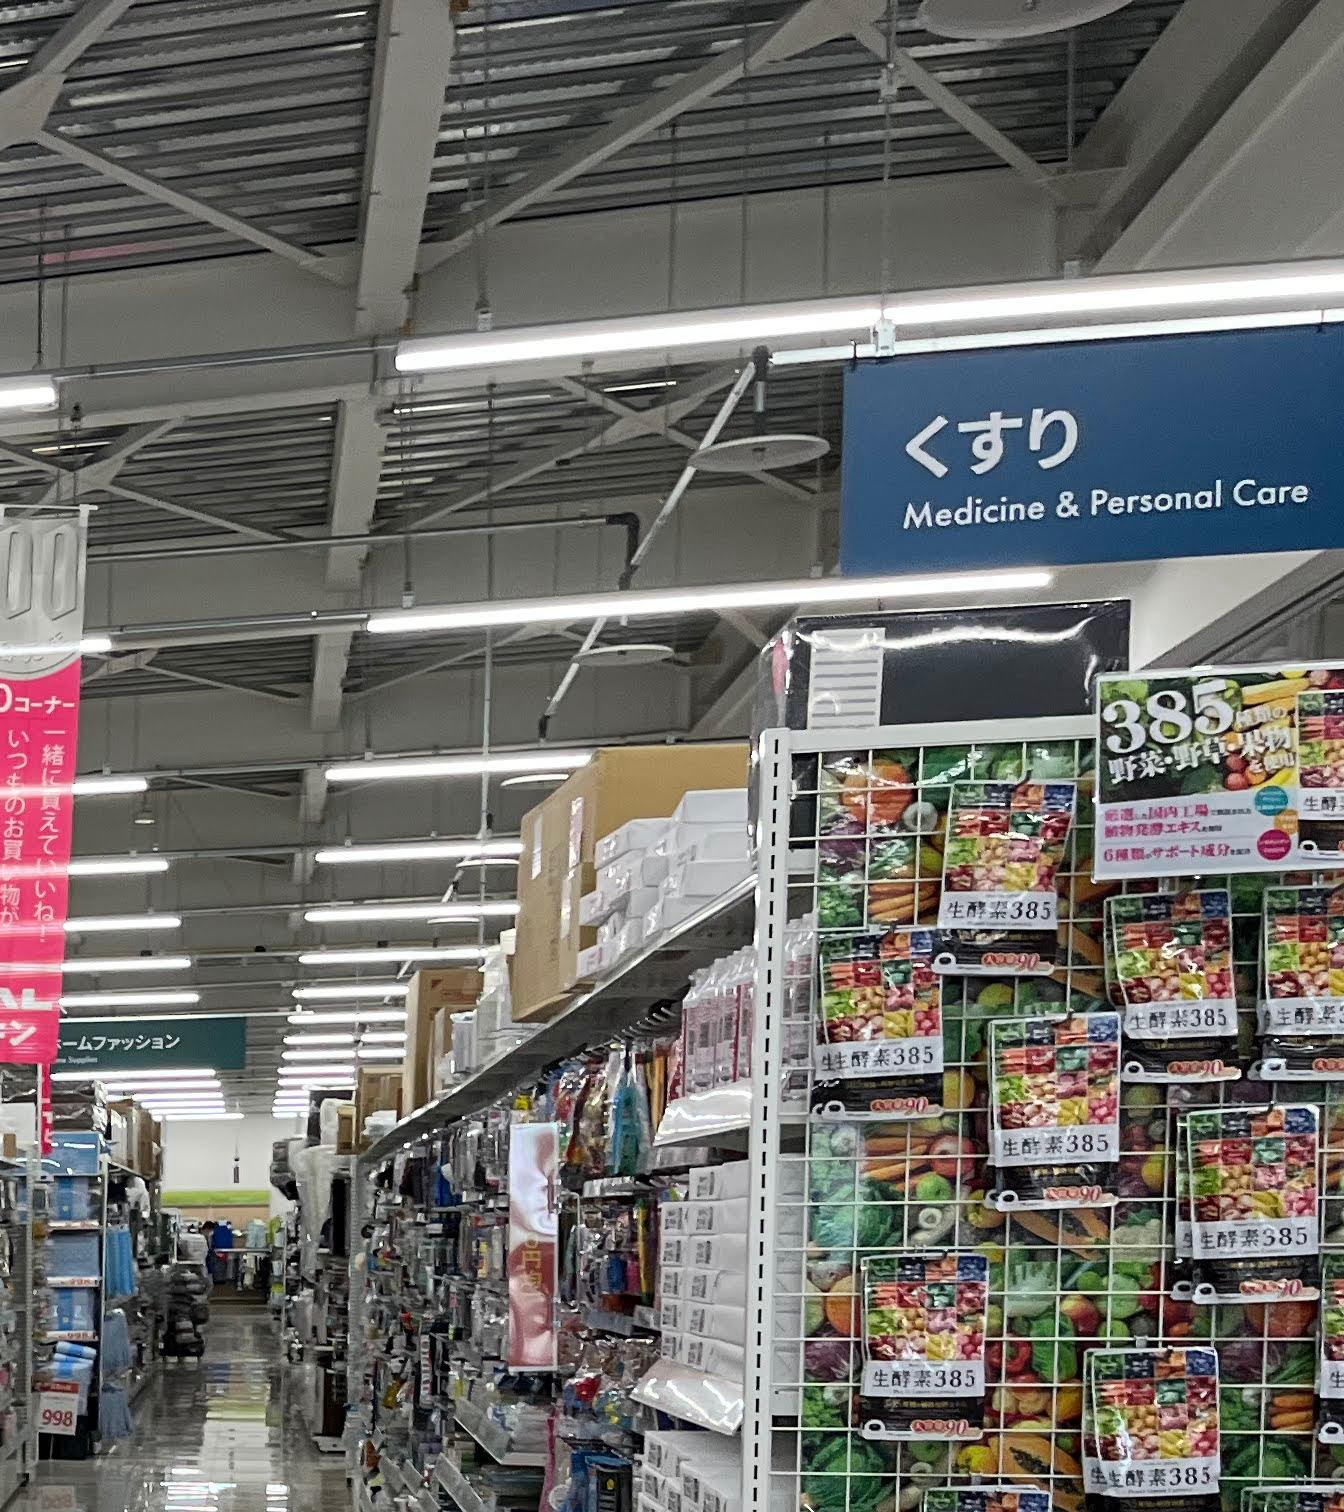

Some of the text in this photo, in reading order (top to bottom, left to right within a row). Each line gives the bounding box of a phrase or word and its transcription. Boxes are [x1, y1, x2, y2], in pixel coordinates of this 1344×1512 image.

[905, 407, 1079, 479] くすり
[903, 479, 1310, 530] Medicine & Personal Care
[1102, 680, 1234, 754] 385
[945, 901, 1053, 922] 生酵素385
[1129, 1007, 1228, 1030] 生酵素385
[56, 1035, 181, 1051] ームファッション
[1002, 1133, 1110, 1156] 生酵素385
[1200, 1226, 1309, 1248] 生酵素385
[872, 1368, 977, 1390] 生酵素385
[41, 1409, 73, 1427] 998
